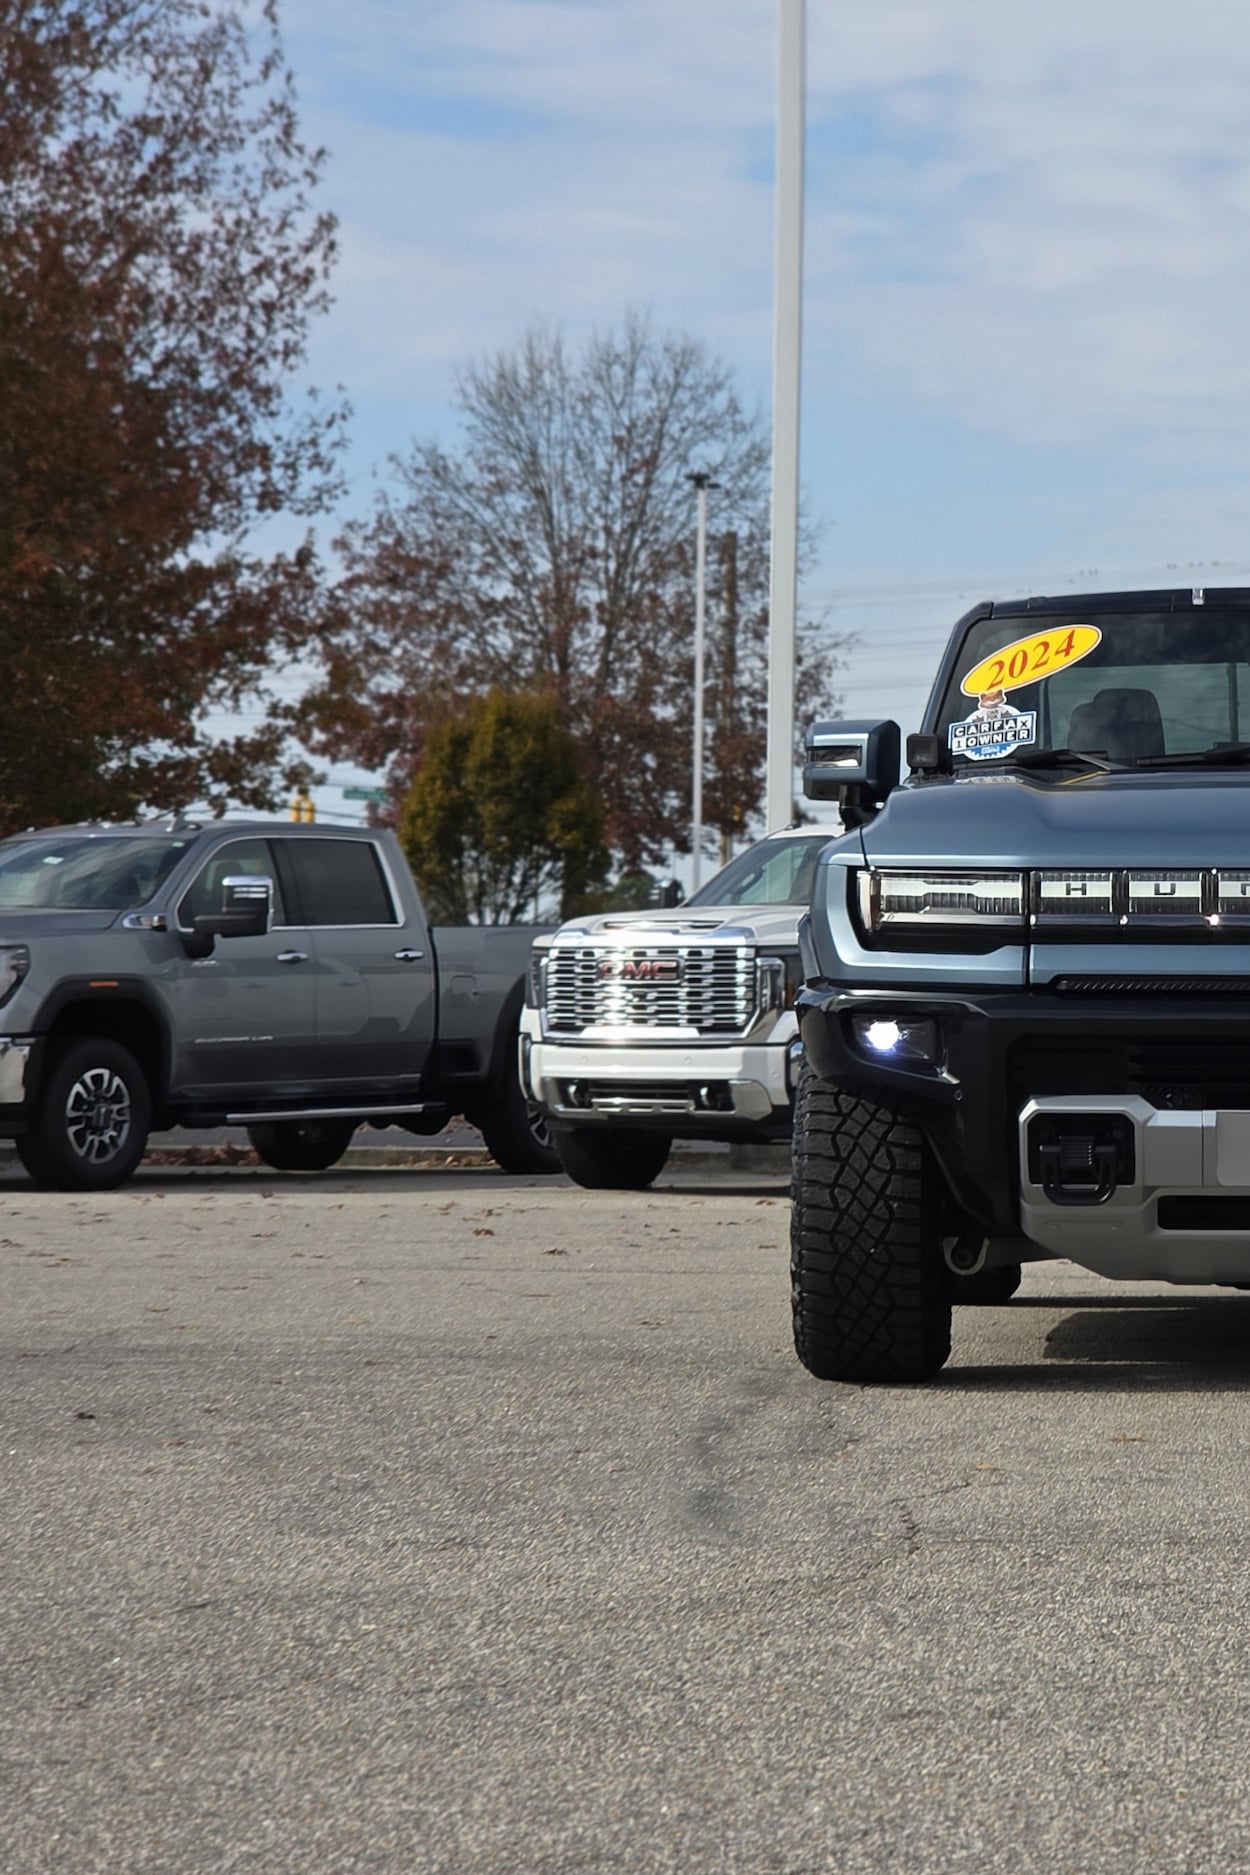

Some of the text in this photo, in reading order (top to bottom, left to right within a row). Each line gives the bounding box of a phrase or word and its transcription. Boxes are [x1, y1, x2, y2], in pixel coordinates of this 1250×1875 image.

[985, 629, 1076, 691] 2024
[955, 719, 1029, 737] CARFAX
[955, 731, 1028, 749] 1 OWNER
[599, 961, 677, 979] GMC
